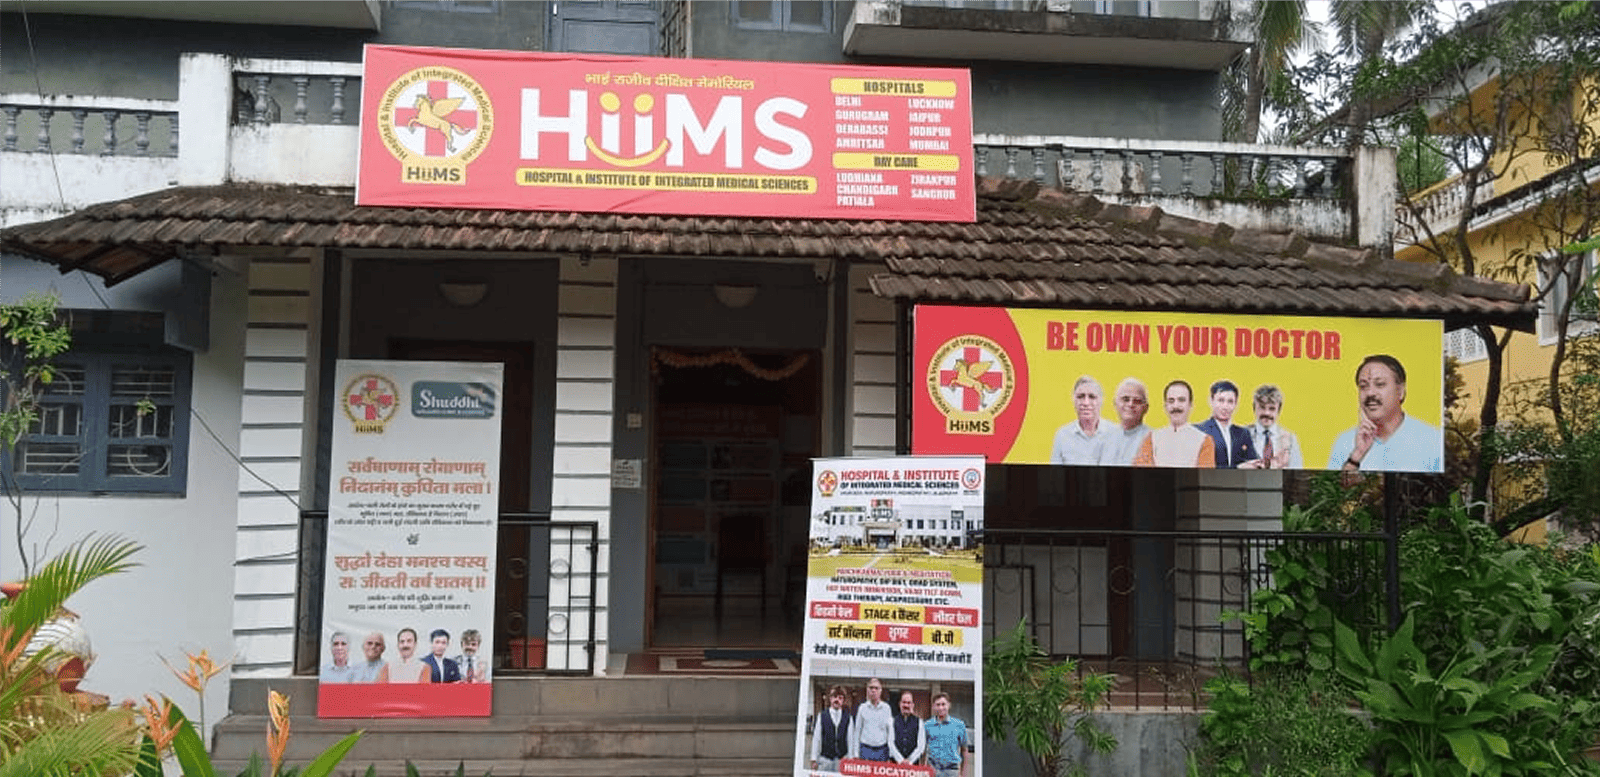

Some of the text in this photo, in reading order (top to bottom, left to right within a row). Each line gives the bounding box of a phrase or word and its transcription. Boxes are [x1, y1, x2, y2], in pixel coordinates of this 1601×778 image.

[411, 72, 420, 81] of
[864, 81, 924, 94] HOSPITALS
[835, 96, 861, 107] DELHI
[908, 99, 954, 110] LUCKNOW
[835, 110, 889, 121] GURUGRAM
[909, 112, 941, 123] JAIPUR
[836, 124, 888, 135] DERABASSI
[909, 126, 952, 137] JODHPUR
[836, 138, 885, 149] AMRITSAR
[909, 140, 949, 151] MUMBAI
[874, 156, 918, 168] DAY CARE
[524, 172, 809, 191] HOSPITAL & INSTITUTE OF INTEGRATED MEDICAL SCIENCES
[837, 173, 883, 184] LUDHIANA
[911, 175, 957, 186] ZIRAKPUR
[837, 184, 898, 195] CHANDIGARH
[911, 189, 956, 200] SANGRUR
[837, 196, 875, 207] PATIALA
[1046, 320, 1341, 360] BE OWN YOUR DOCTOR
[841, 470, 960, 481] HOSPITAL & INSTITUTE
[840, 481, 960, 489] OF INTEGRATED MEDICAL SCIENCES
[864, 608, 890, 619] STAGE
[891, 610, 897, 619] 4
